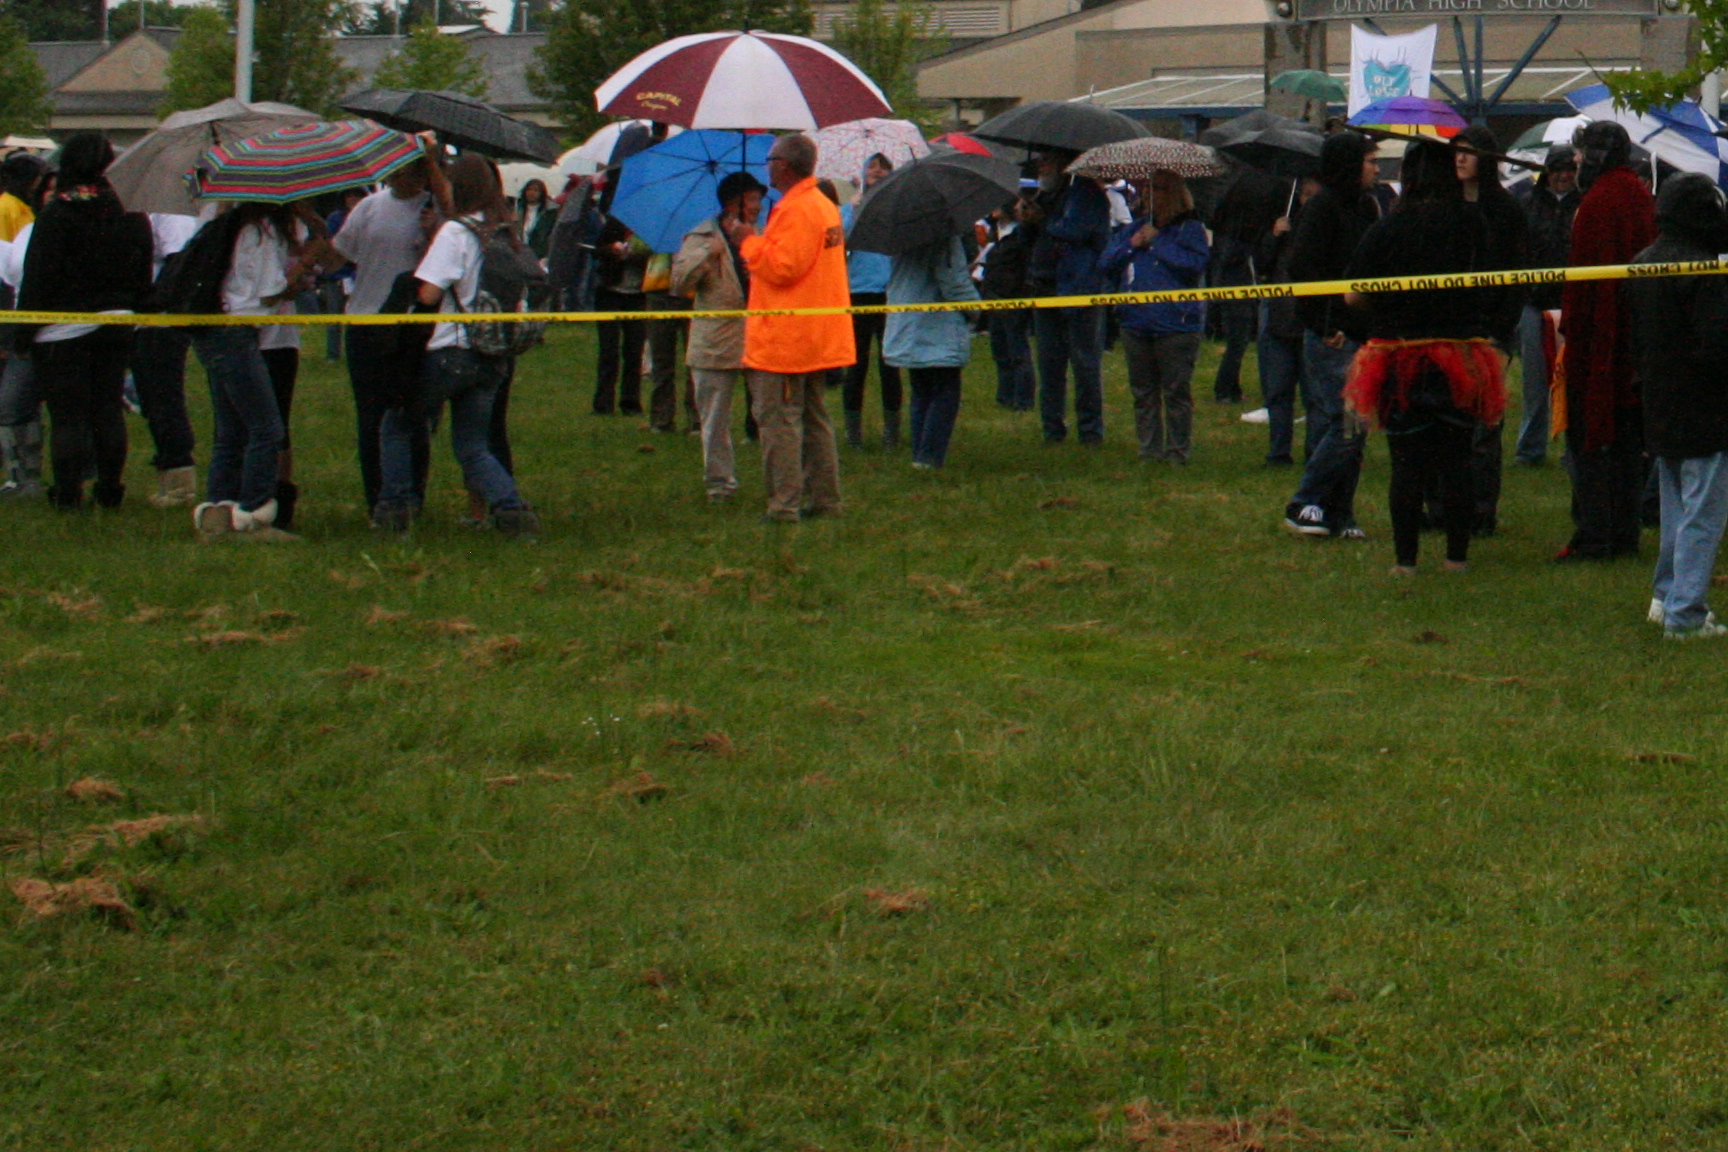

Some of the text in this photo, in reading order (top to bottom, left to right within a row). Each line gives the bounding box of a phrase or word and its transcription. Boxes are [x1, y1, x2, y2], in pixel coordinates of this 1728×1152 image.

[1627, 263, 1681, 275] CROSS
[1689, 259, 1719, 270] NOT
[1350, 269, 1566, 293] POLICE LINE DO NOT CROSS
[1202, 289, 1236, 300] LINE
[1240, 286, 1294, 298] POLICE
